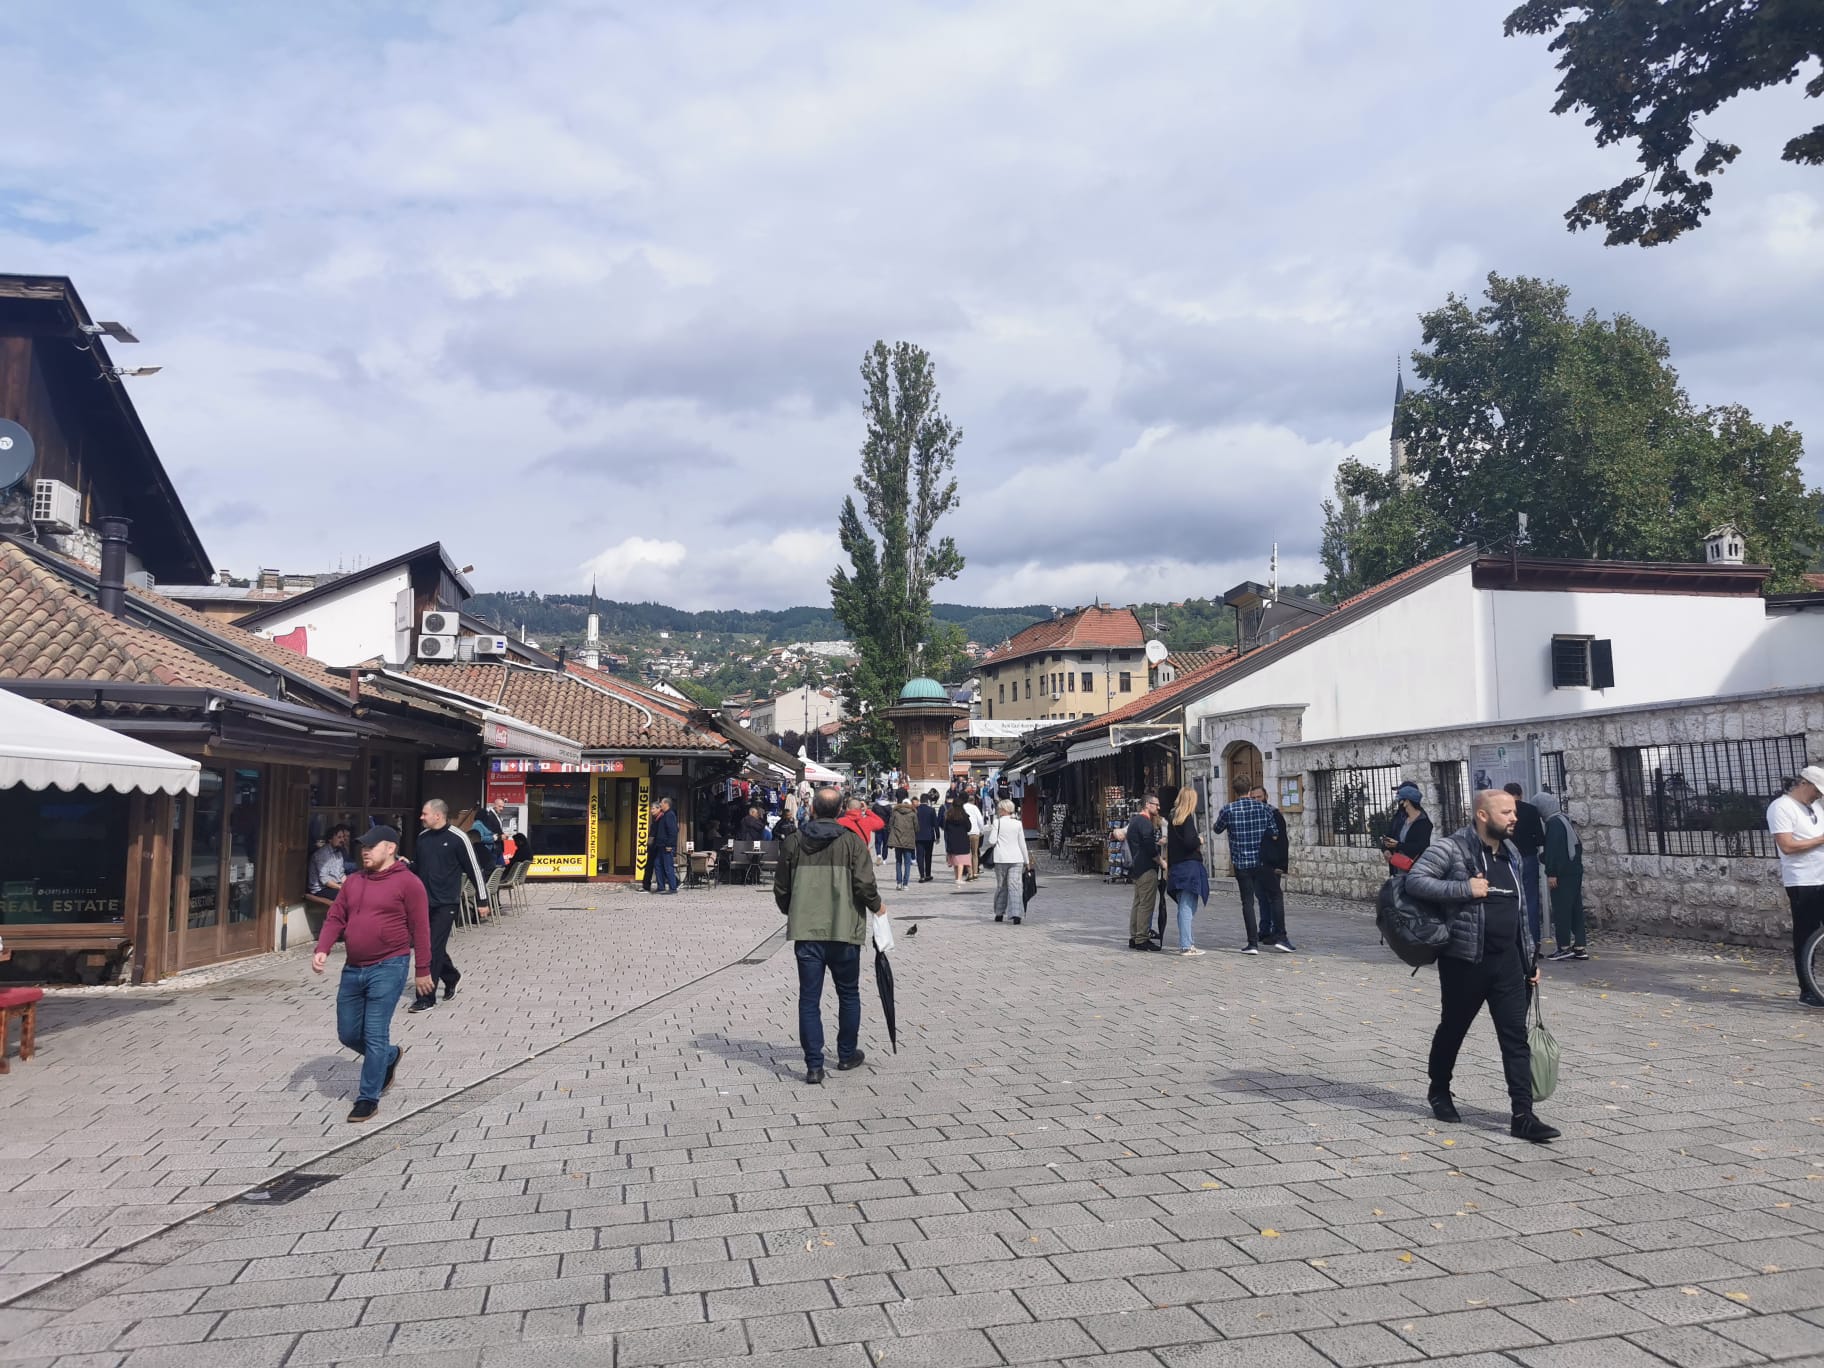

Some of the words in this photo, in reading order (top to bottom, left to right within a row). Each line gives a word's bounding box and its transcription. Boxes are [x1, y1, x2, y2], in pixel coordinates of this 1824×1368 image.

[638, 785, 649, 856] EXCHANGE
[531, 857, 583, 865] EXCHANGE
[0, 899, 43, 913] REAL
[52, 899, 120, 912] ESTATE
